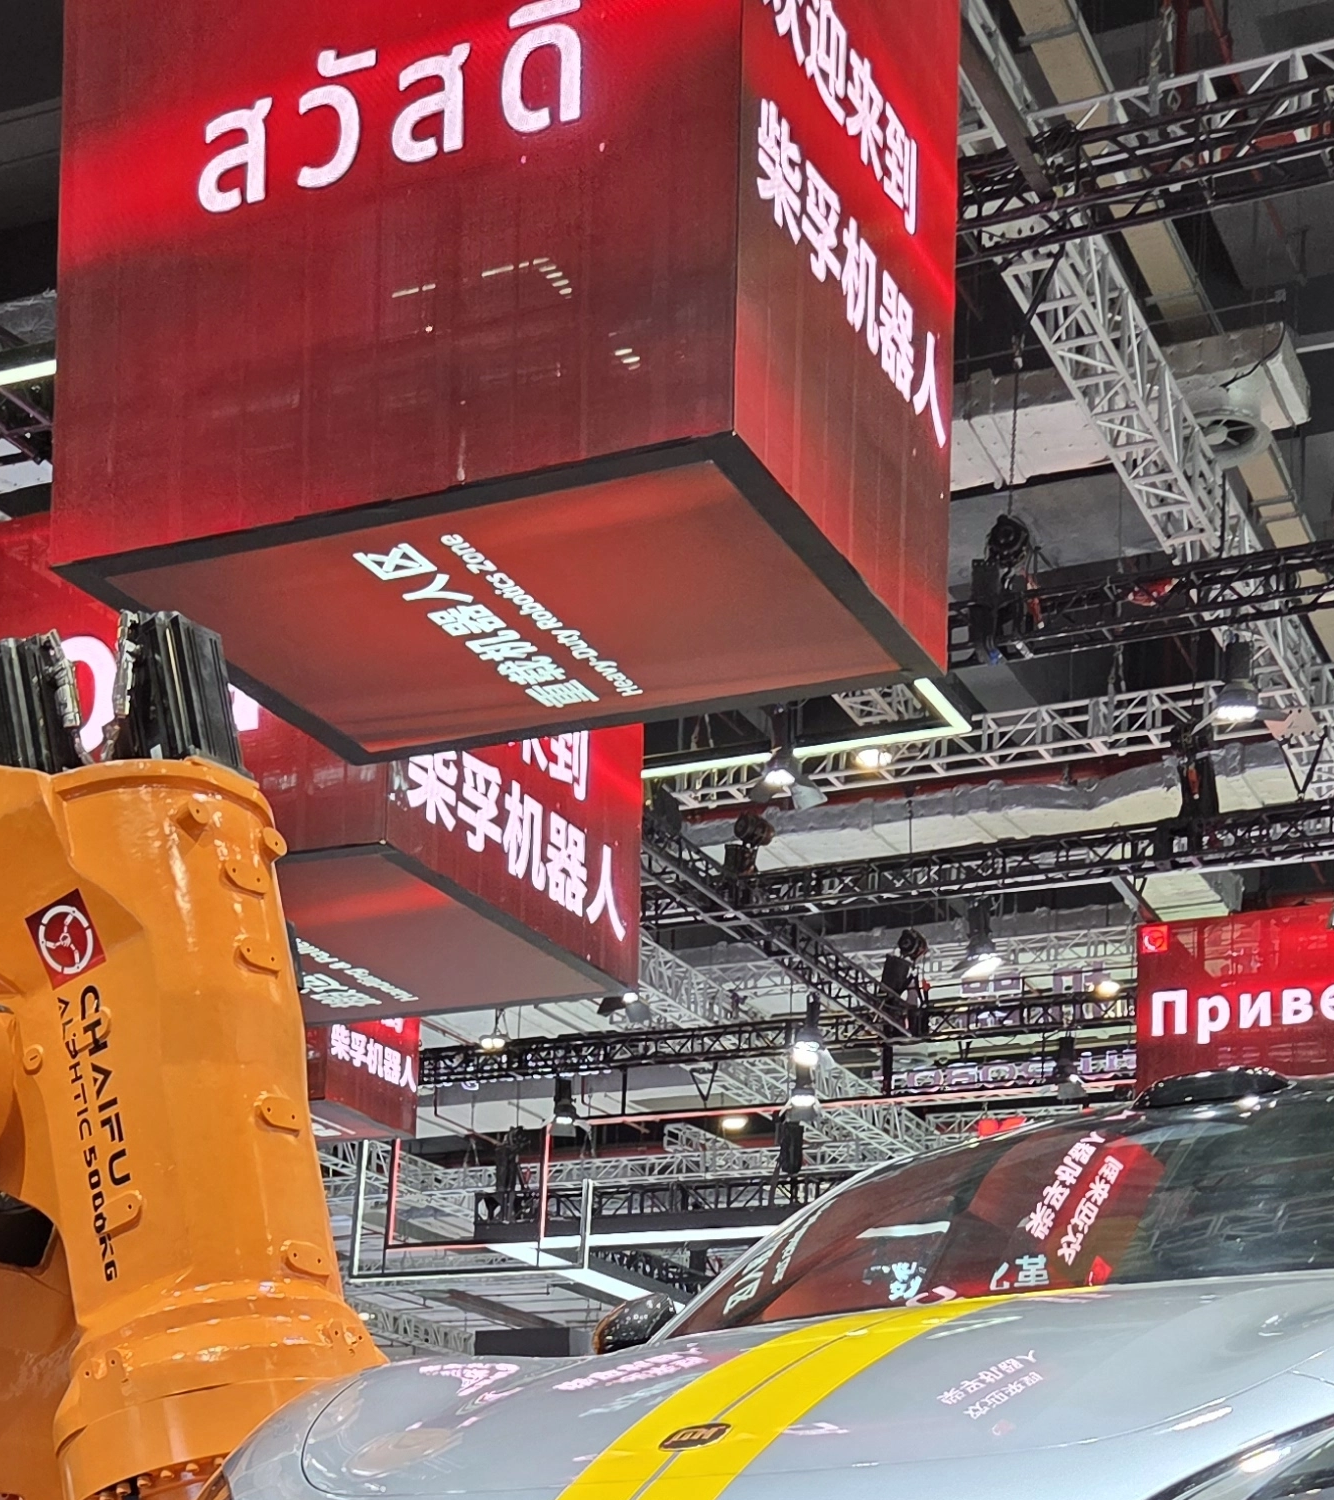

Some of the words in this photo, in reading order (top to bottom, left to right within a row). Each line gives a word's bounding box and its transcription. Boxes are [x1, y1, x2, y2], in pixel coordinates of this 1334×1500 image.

[757, 98, 946, 449] 柴孚机器人
[353, 542, 599, 708] 重载机器人区
[440, 533, 497, 574] Zone
[485, 572, 563, 630] Robotics
[551, 629, 644, 697] Heavy-Duty
[407, 750, 626, 941] 柴孚机器人
[80, 985, 131, 1186] CHAIFU
[83, 1146, 118, 1282] 5000KG
